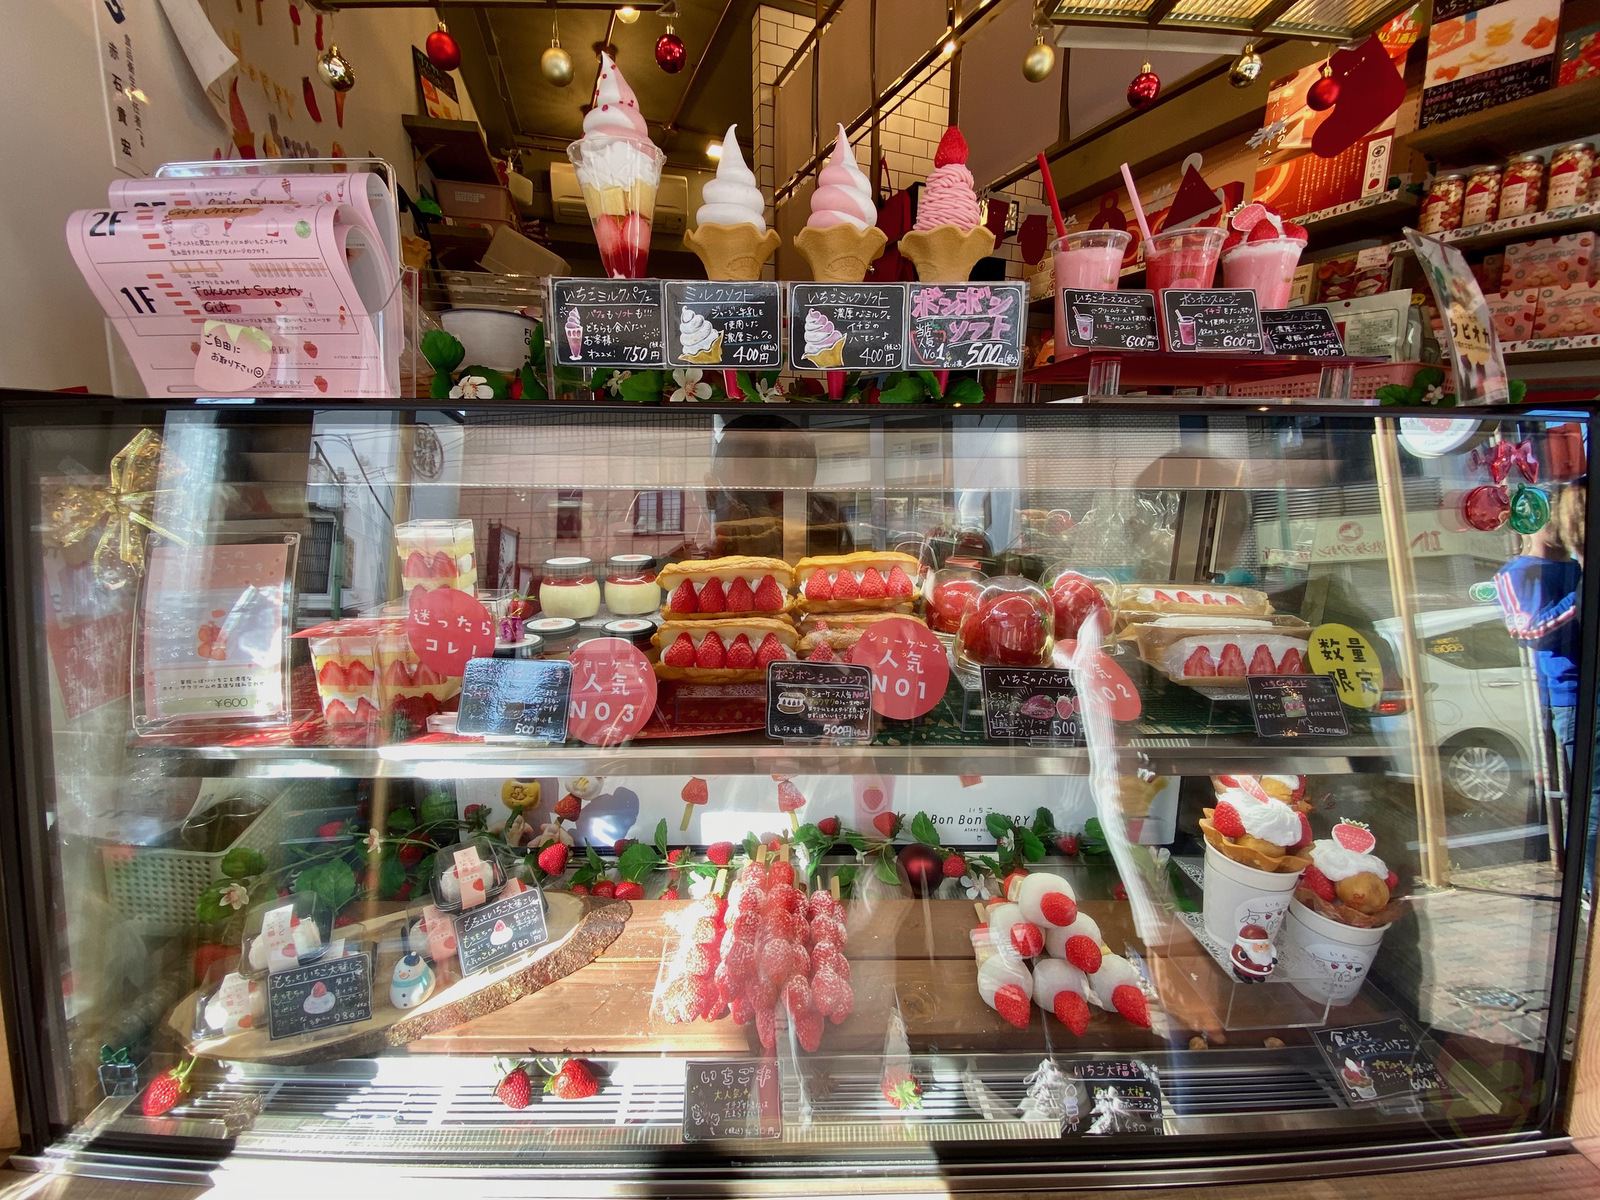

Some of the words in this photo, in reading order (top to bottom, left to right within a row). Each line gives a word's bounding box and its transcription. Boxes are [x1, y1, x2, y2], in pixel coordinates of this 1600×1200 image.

[89, 210, 128, 237] 2F
[120, 286, 158, 314] 1F
[191, 285, 251, 298] Takeout
[253, 285, 304, 298] Sweets
[563, 286, 653, 305] いちごミルクパフェ
[684, 285, 755, 303] ミルクソフト
[807, 287, 889, 306] いちごミルクソフト
[203, 301, 232, 314] Gift
[833, 307, 892, 320] 濃厚なミルクと
[1262, 311, 1322, 322] ムージーパフェ
[723, 320, 759, 331] 使用した
[846, 320, 880, 332] イチゴの
[915, 322, 933, 338] 当店
[948, 316, 1011, 343] ソフト
[204, 332, 241, 355] ご自由に
[1126, 335, 1155, 348] 600円
[1223, 335, 1256, 348] 600円
[622, 346, 660, 362] 750円
[733, 345, 770, 364] 400円
[859, 347, 895, 366] 400円
[1309, 347, 1339, 356] 900円
[210, 352, 254, 374] お取り下さい
[411, 607, 492, 636] 迷ったら
[1317, 636, 1368, 664] 数量
[569, 656, 649, 673] ショーケース
[876, 649, 925, 676] 人気
[581, 672, 632, 697] 人気
[1332, 666, 1380, 695] 限定
[214, 697, 249, 709] ¥600
[823, 723, 852, 737] 500円
[930, 814, 954, 825] Bon
[958, 814, 982, 825] Bon
[511, 934, 543, 951] 280円
[333, 1009, 366, 1022] 280円
